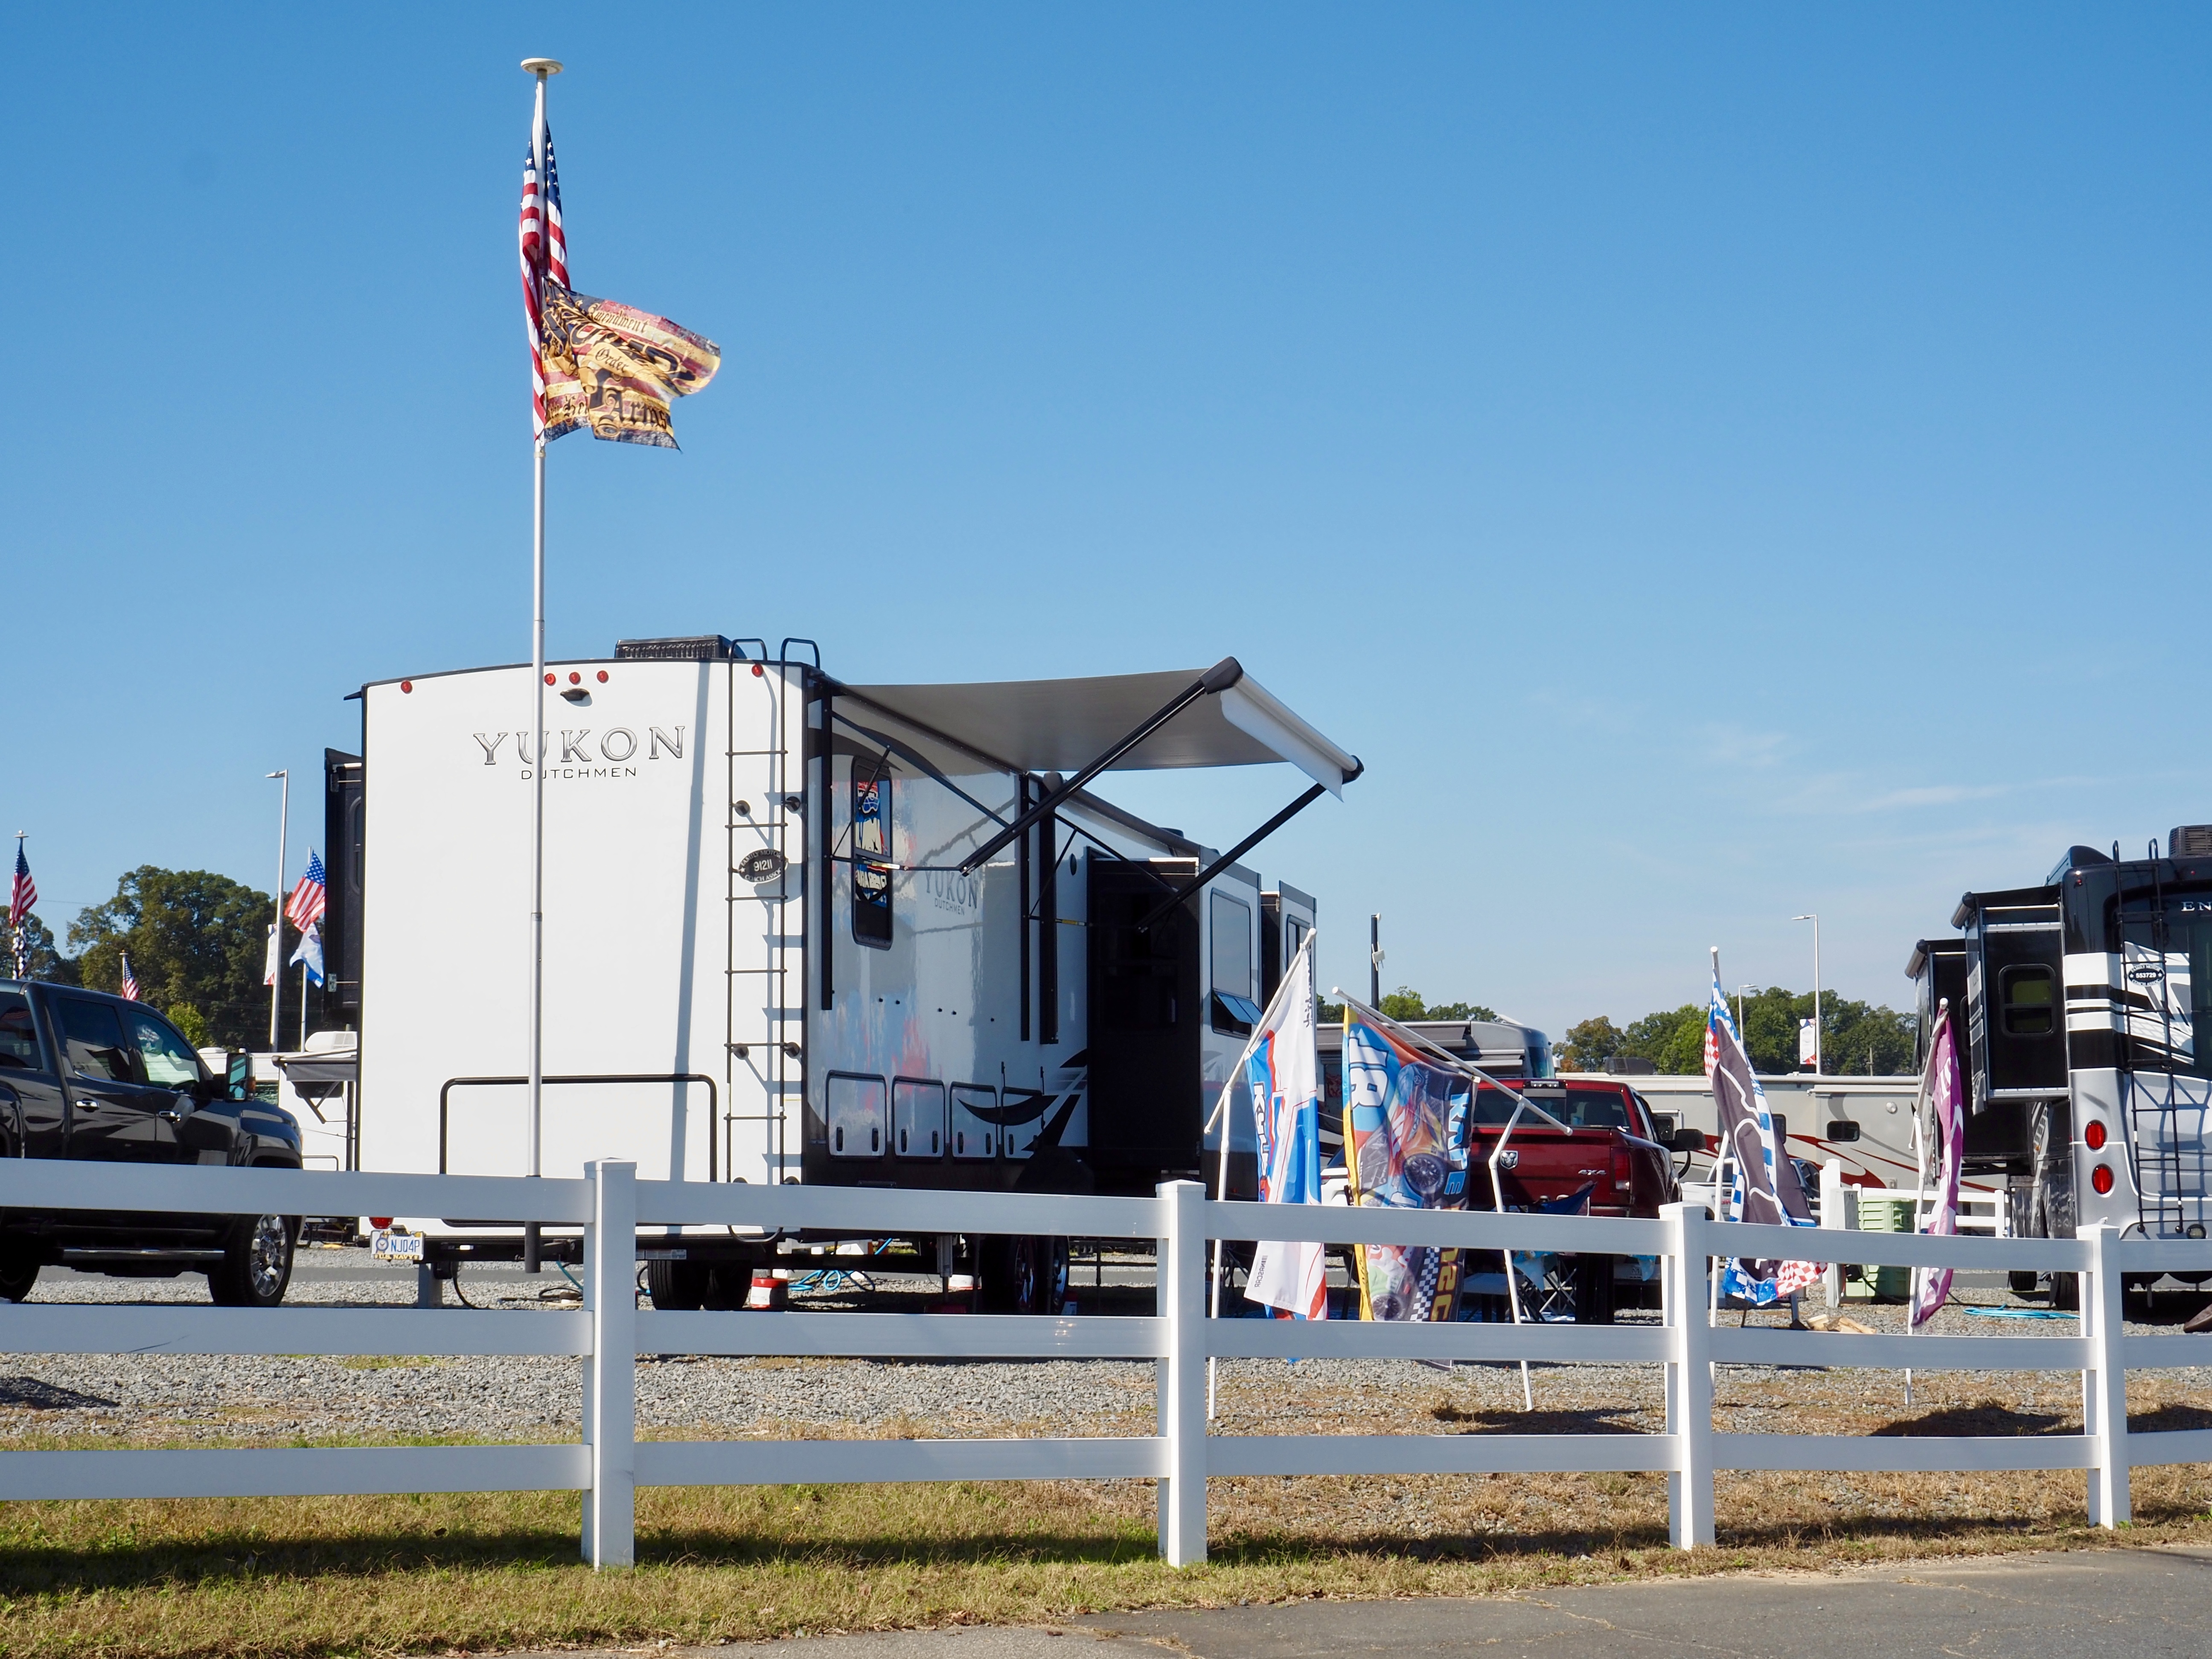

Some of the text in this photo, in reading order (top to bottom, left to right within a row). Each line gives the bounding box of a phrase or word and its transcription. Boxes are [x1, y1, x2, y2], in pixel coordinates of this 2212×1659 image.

[595, 347, 629, 373] Order
[473, 726, 685, 765] YUKON
[754, 859, 773, 872] 91211
[934, 898, 965, 916] DUTCHMEN
